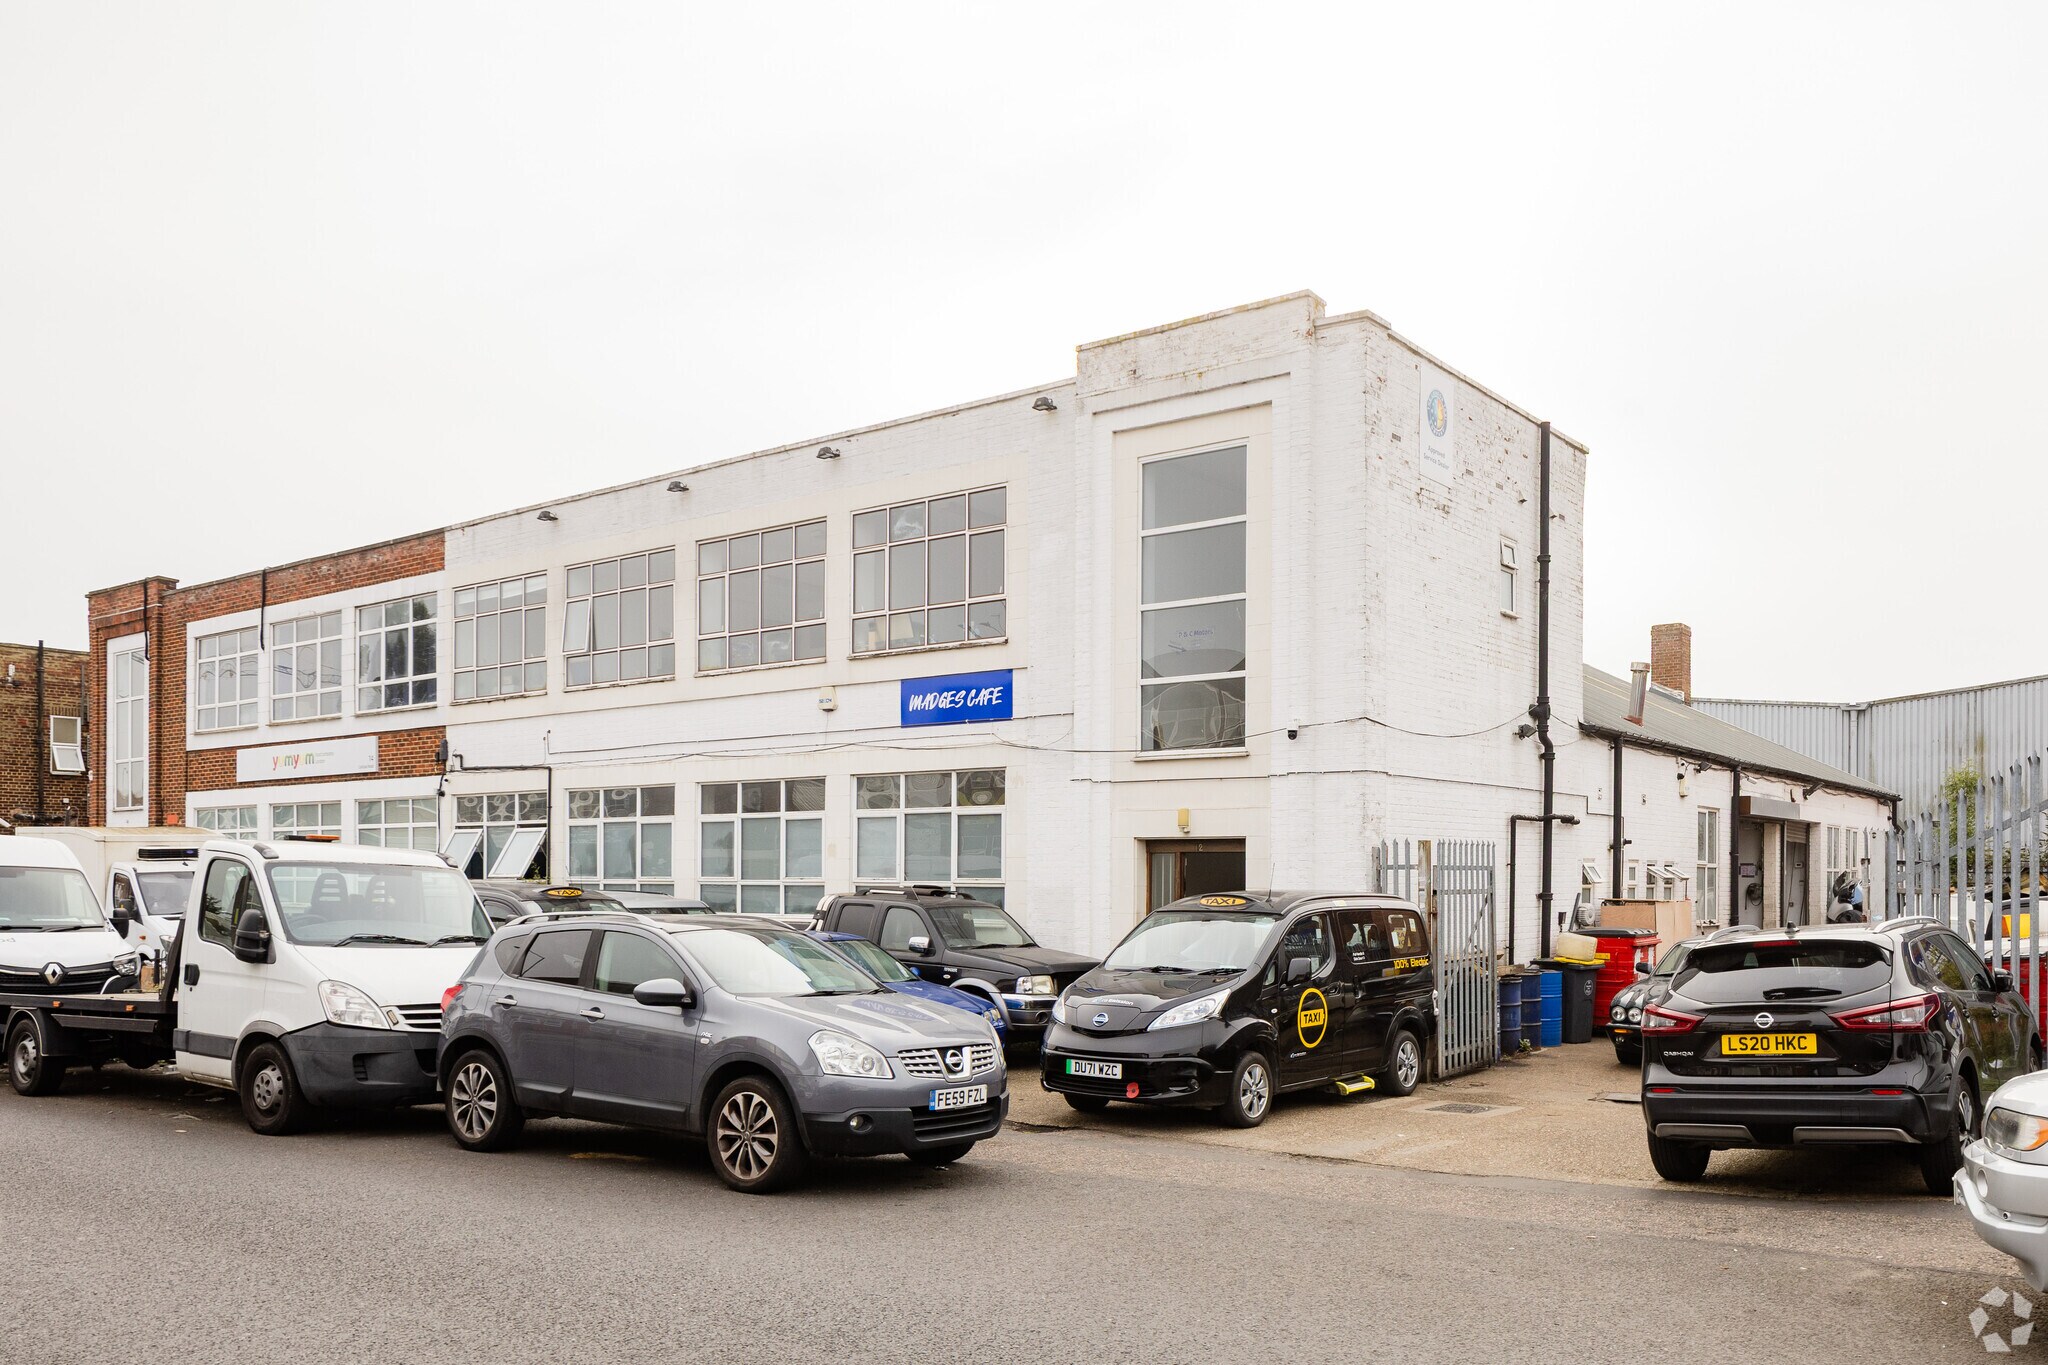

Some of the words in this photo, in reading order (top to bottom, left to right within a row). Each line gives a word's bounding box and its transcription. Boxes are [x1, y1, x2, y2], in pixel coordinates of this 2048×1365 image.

[908, 689, 967, 712] MADGES
[966, 686, 1004, 707] CAFE
[1205, 897, 1237, 905] TAXI
[1393, 959, 1410, 970] 100%
[1410, 957, 1429, 968] Electric
[1303, 1012, 1321, 1024] TAXI
[1727, 1036, 1770, 1052] LS20
[1775, 1035, 1808, 1051] HKC
[1074, 1061, 1096, 1075] DU71
[1098, 1063, 1118, 1077] WZC
[937, 1090, 965, 1107] FE59
[967, 1088, 985, 1104] FZL
